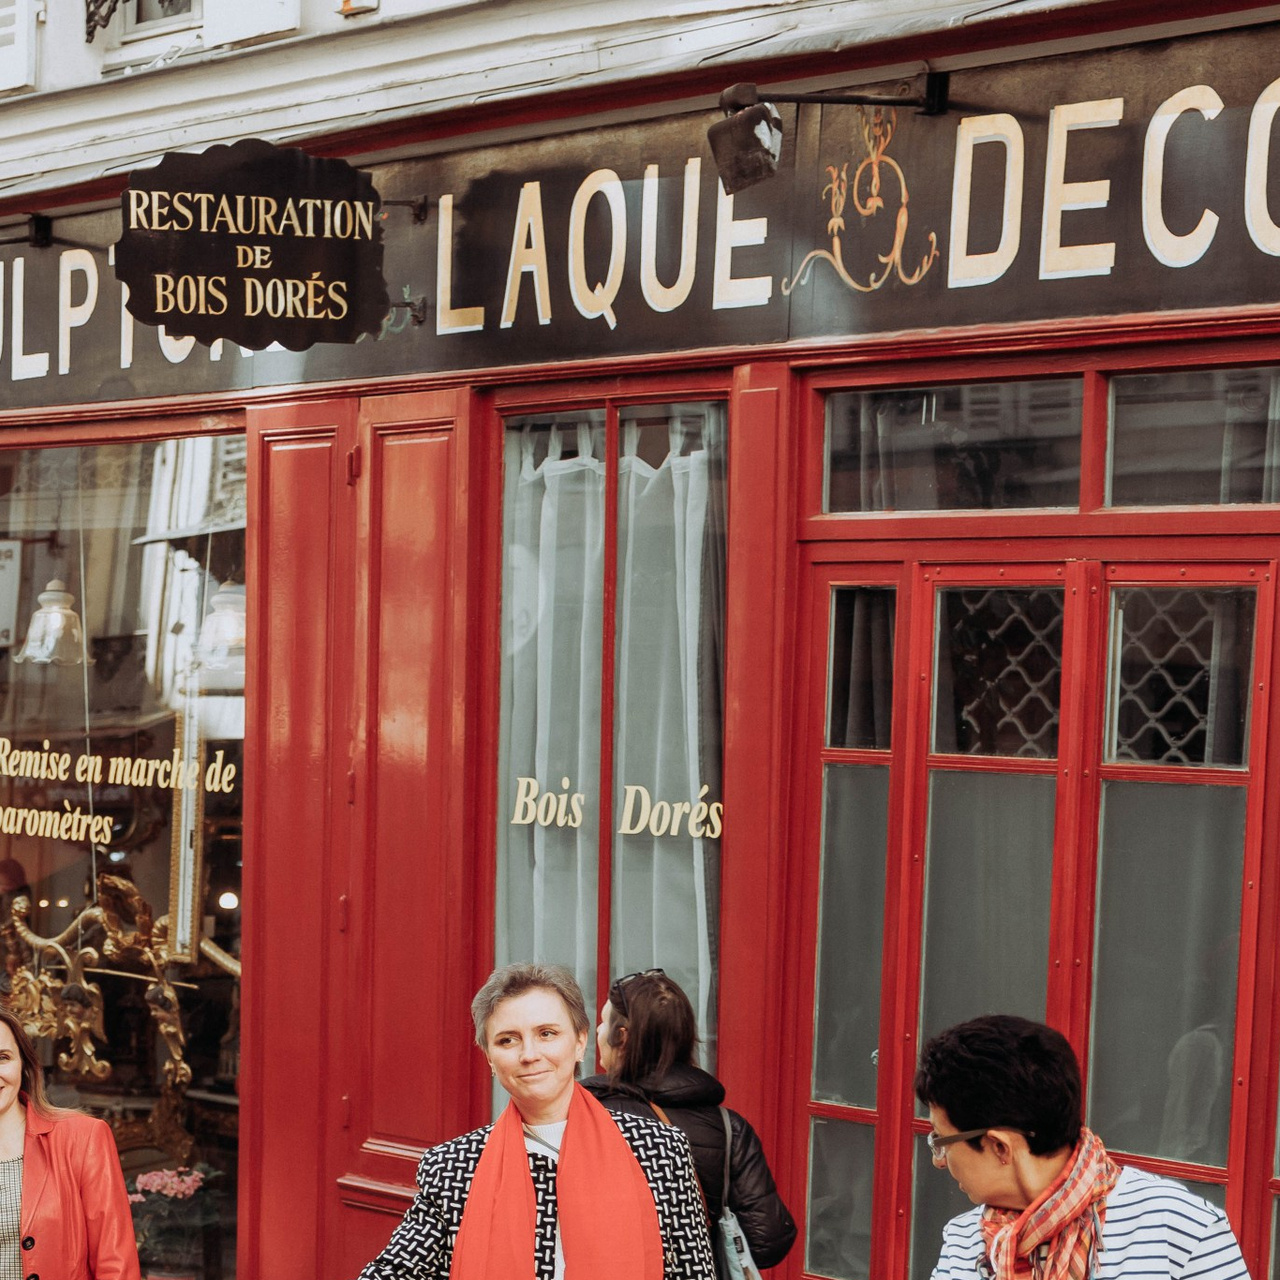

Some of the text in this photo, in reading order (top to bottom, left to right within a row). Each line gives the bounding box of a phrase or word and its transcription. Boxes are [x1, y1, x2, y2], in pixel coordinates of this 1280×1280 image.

[128, 189, 374, 242] RESTAURATION
[235, 244, 274, 270] DE
[436, 156, 773, 335] LAQUE
[154, 271, 349, 320] BOIS DORÉS
[74, 751, 103, 785] en
[107, 748, 200, 791] marche
[204, 749, 237, 794] de
[510, 776, 724, 839] Bois Dorés
